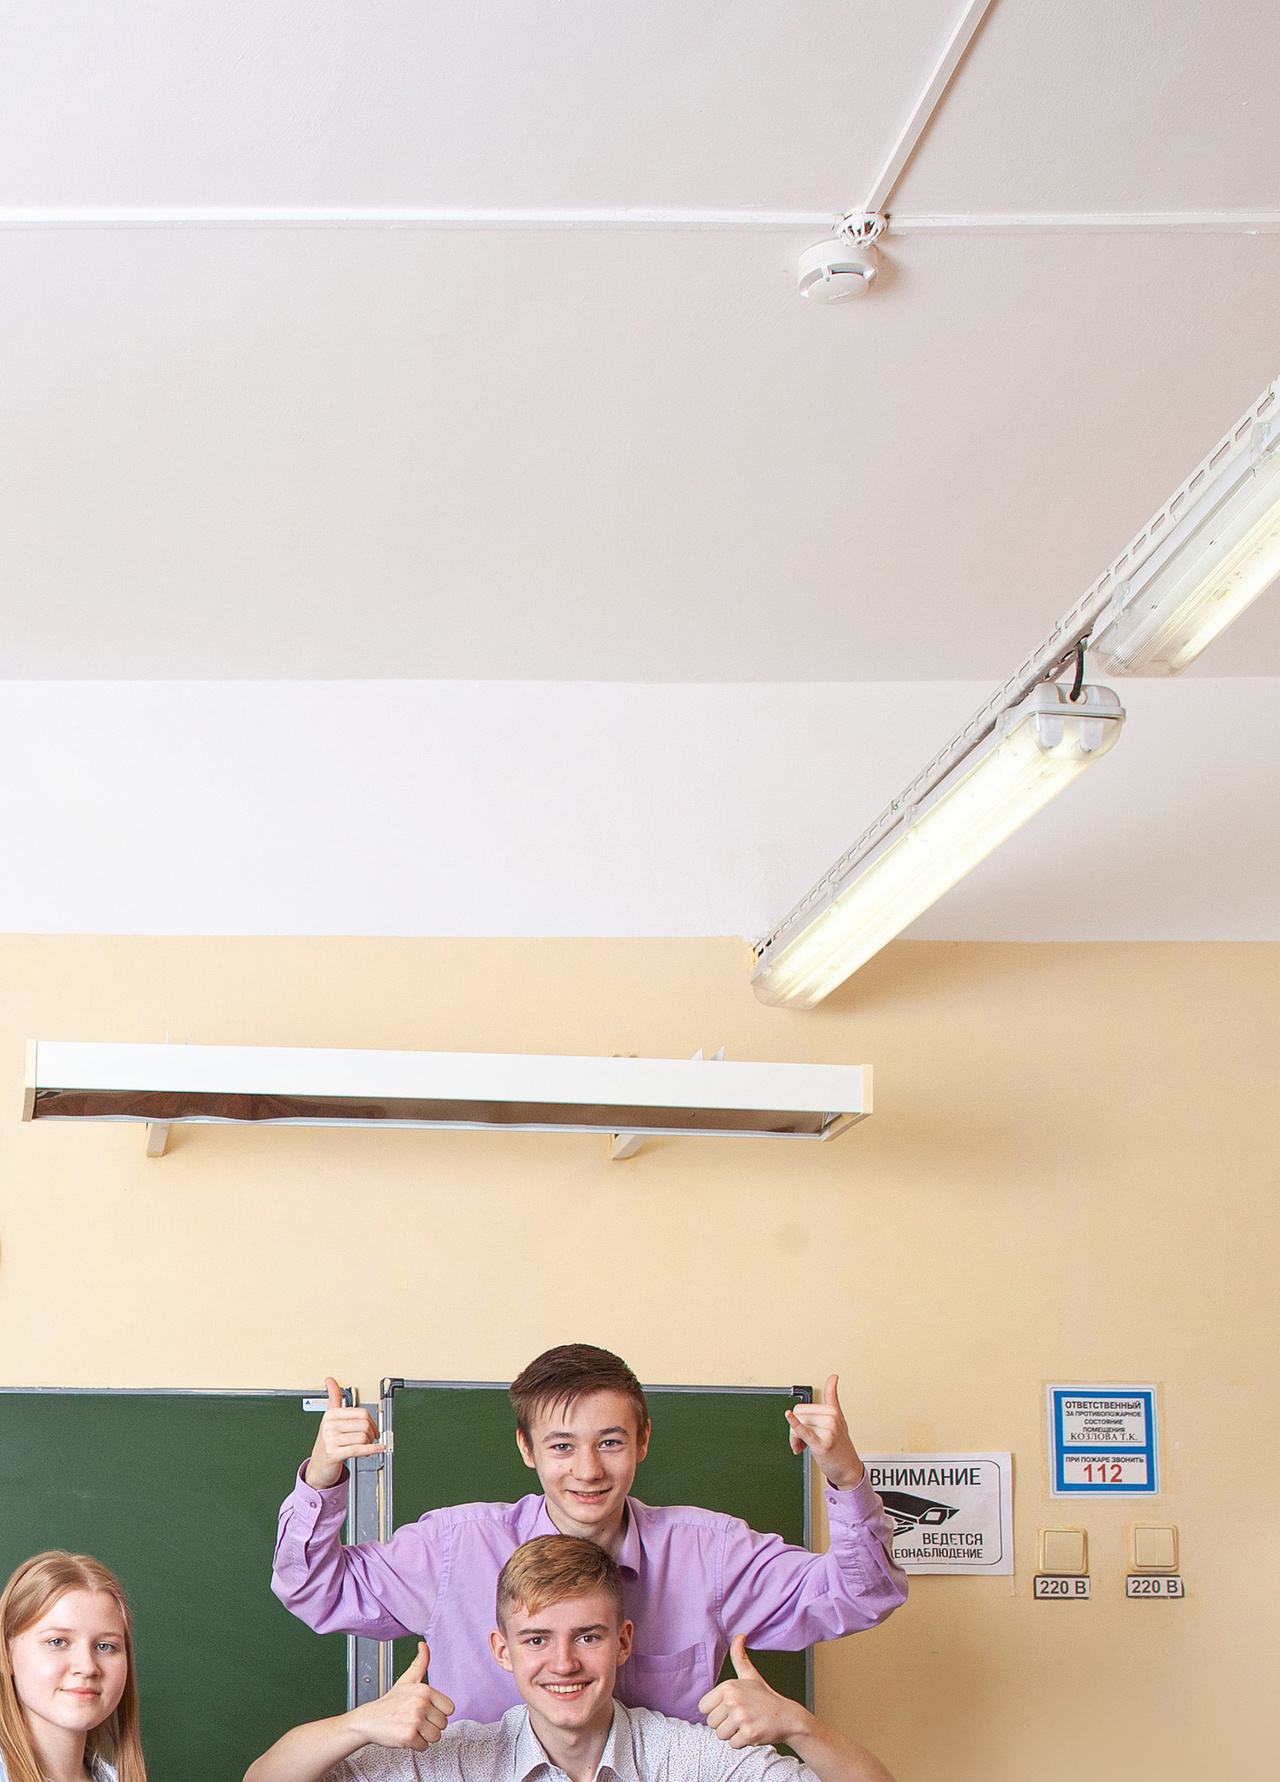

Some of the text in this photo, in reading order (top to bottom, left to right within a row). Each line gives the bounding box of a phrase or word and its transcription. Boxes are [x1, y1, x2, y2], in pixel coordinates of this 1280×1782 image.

[1065, 1401, 1141, 1409] ОТВЕТСТВЕННЫЙ
[870, 1468, 981, 1486] ВНИМАНИЕ
[1084, 1464, 1122, 1482] 112
[923, 1533, 983, 1546] ВЕДЕТСЯ
[1040, 1581, 1086, 1594] 220 В
[1132, 1580, 1178, 1593] 220 В
